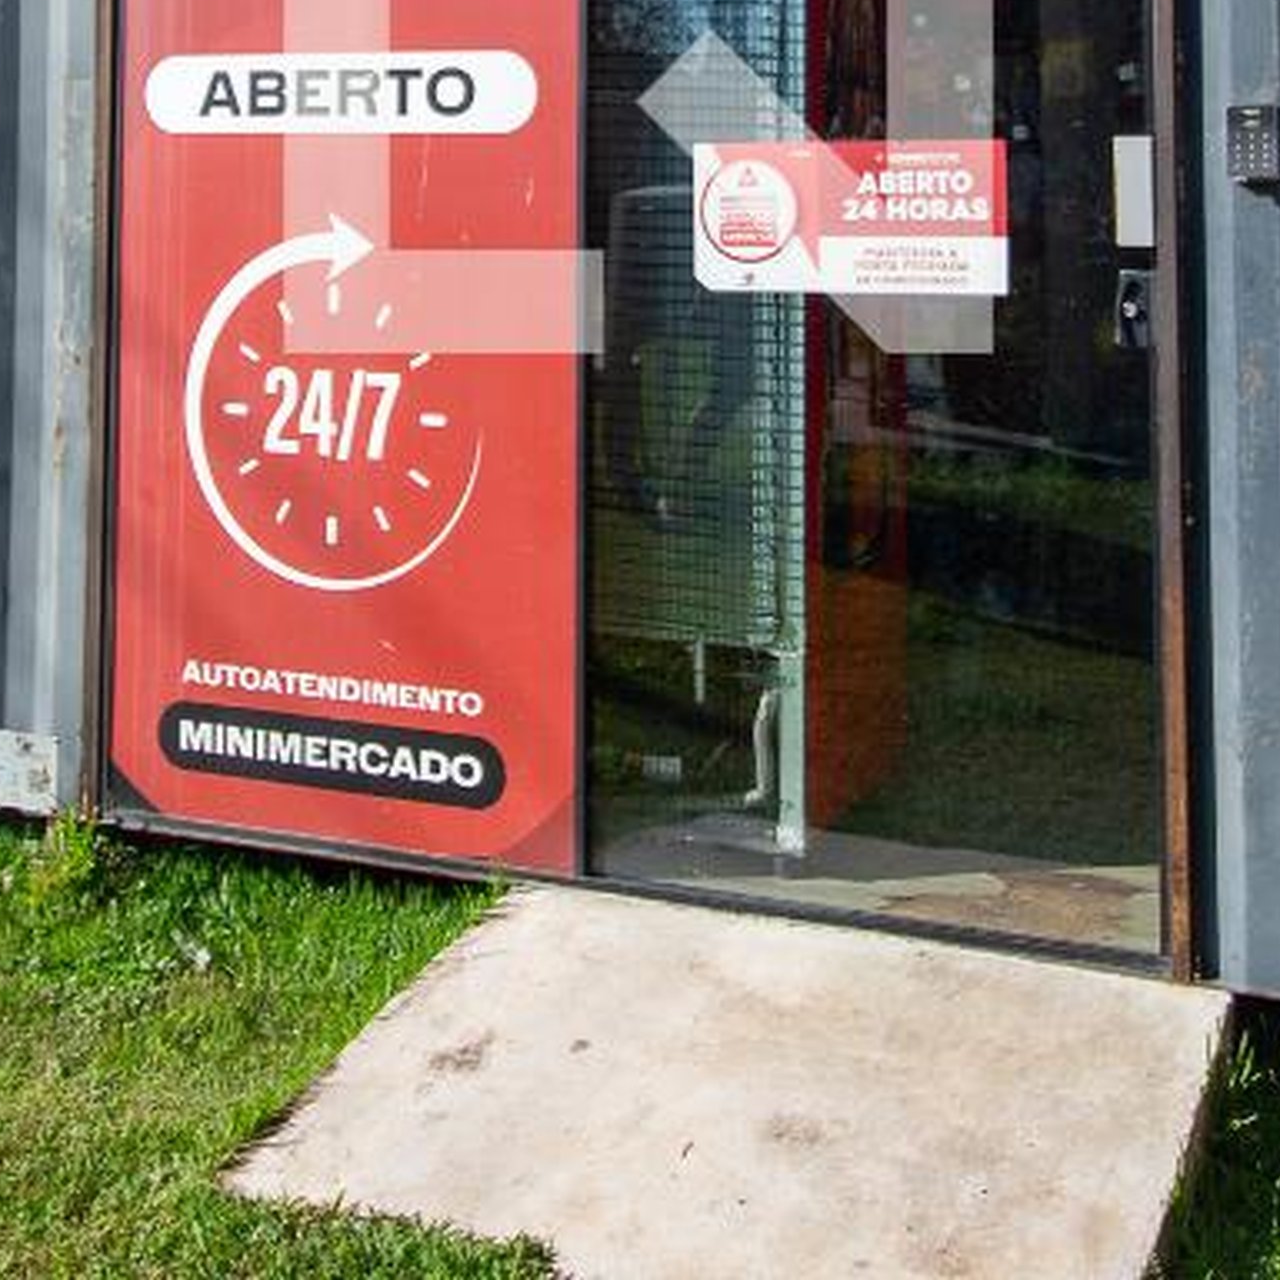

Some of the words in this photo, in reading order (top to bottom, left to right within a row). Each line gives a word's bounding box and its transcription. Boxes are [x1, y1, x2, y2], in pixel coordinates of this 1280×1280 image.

[198, 66, 476, 117] ABERTO
[842, 197, 880, 221] 24
[885, 197, 990, 221] HORAS
[856, 170, 974, 195] ABERTO
[262, 365, 402, 462] 24/7
[181, 659, 485, 717] AUTOATENDIMENTO
[177, 718, 485, 789] MINIMERCADO
